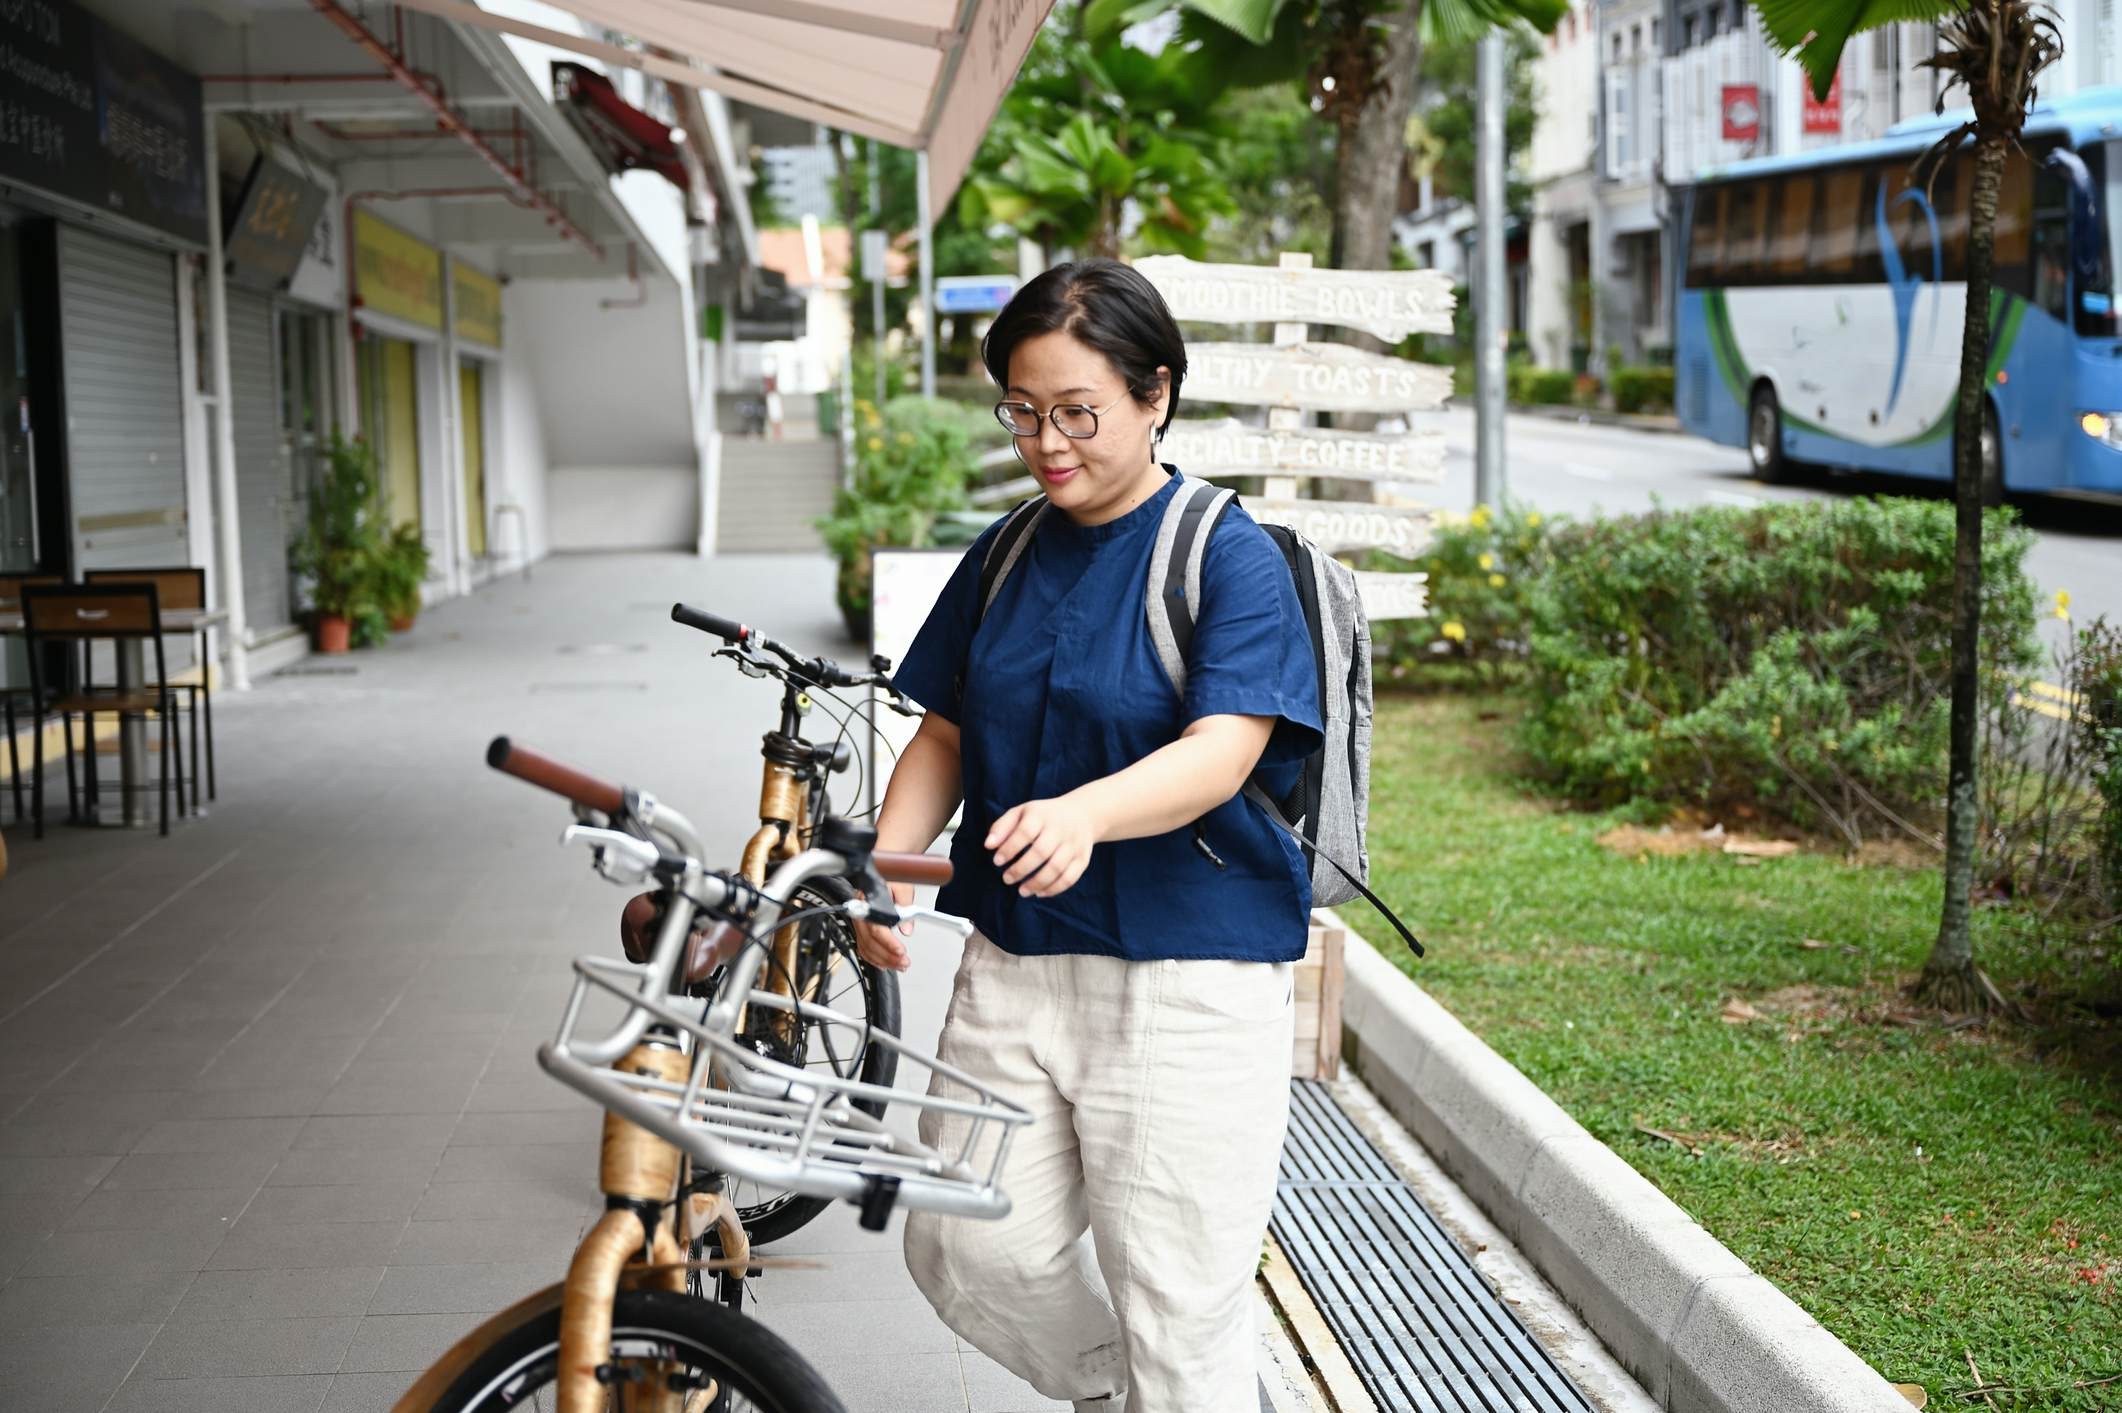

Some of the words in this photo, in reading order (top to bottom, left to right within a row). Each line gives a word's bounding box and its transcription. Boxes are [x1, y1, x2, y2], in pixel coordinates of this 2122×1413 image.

[1317, 286, 1424, 321] BOWLS
[1189, 355, 1273, 388] ALTHY
[1290, 362, 1417, 399] TOASTS
[1164, 430, 1285, 466] PECIALTY
[1300, 438, 1406, 471] COFFEE
[1304, 511, 1412, 546] GOODS
